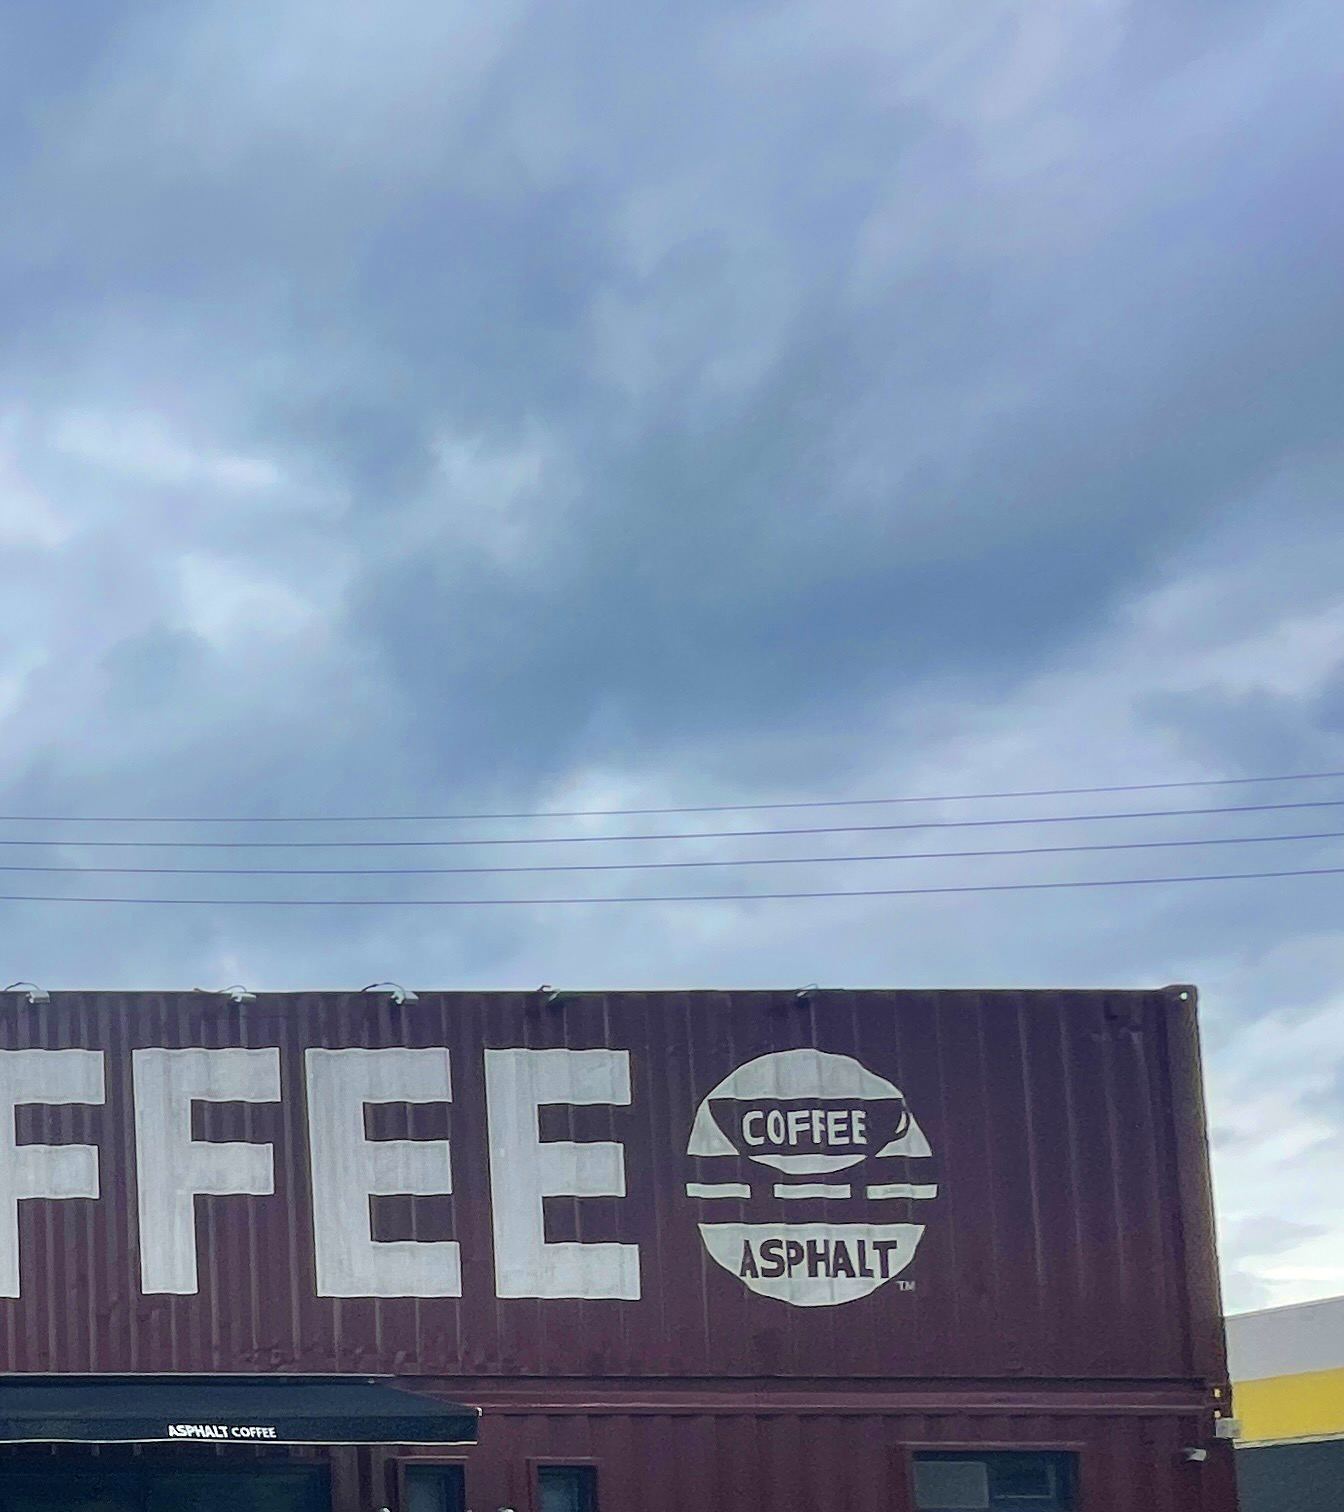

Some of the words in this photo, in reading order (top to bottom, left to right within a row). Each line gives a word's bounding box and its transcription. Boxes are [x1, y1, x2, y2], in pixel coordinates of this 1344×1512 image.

[742, 1109, 868, 1146] COFFEE
[739, 1238, 898, 1279] ASPHALT
[168, 1424, 229, 1439] ASPHALT
[231, 1426, 277, 1439] COFFEE
